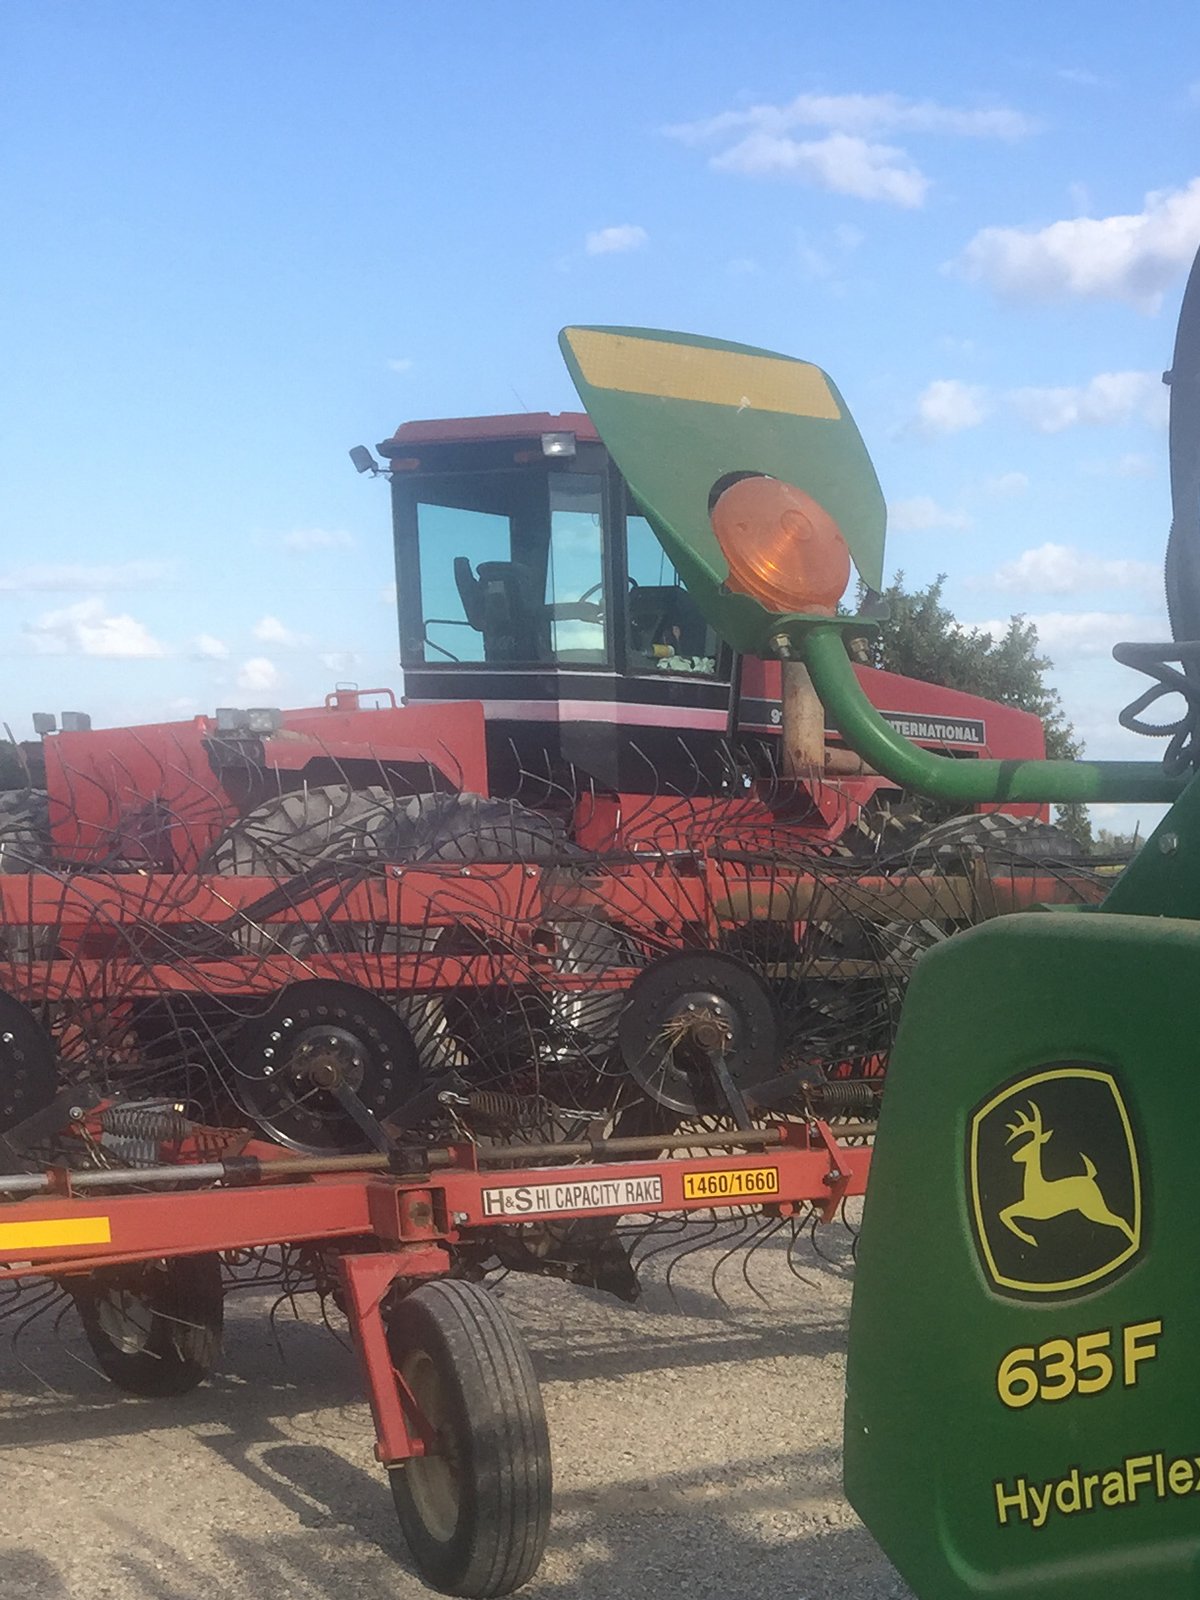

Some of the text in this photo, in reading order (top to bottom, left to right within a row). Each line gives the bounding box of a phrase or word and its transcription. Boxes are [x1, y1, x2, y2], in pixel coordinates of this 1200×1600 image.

[885, 719, 979, 742] NTERNATIONAL
[687, 1171, 776, 1195] 1460/1660
[486, 1179, 661, 1214] H&S HI CAPACITY RAKE
